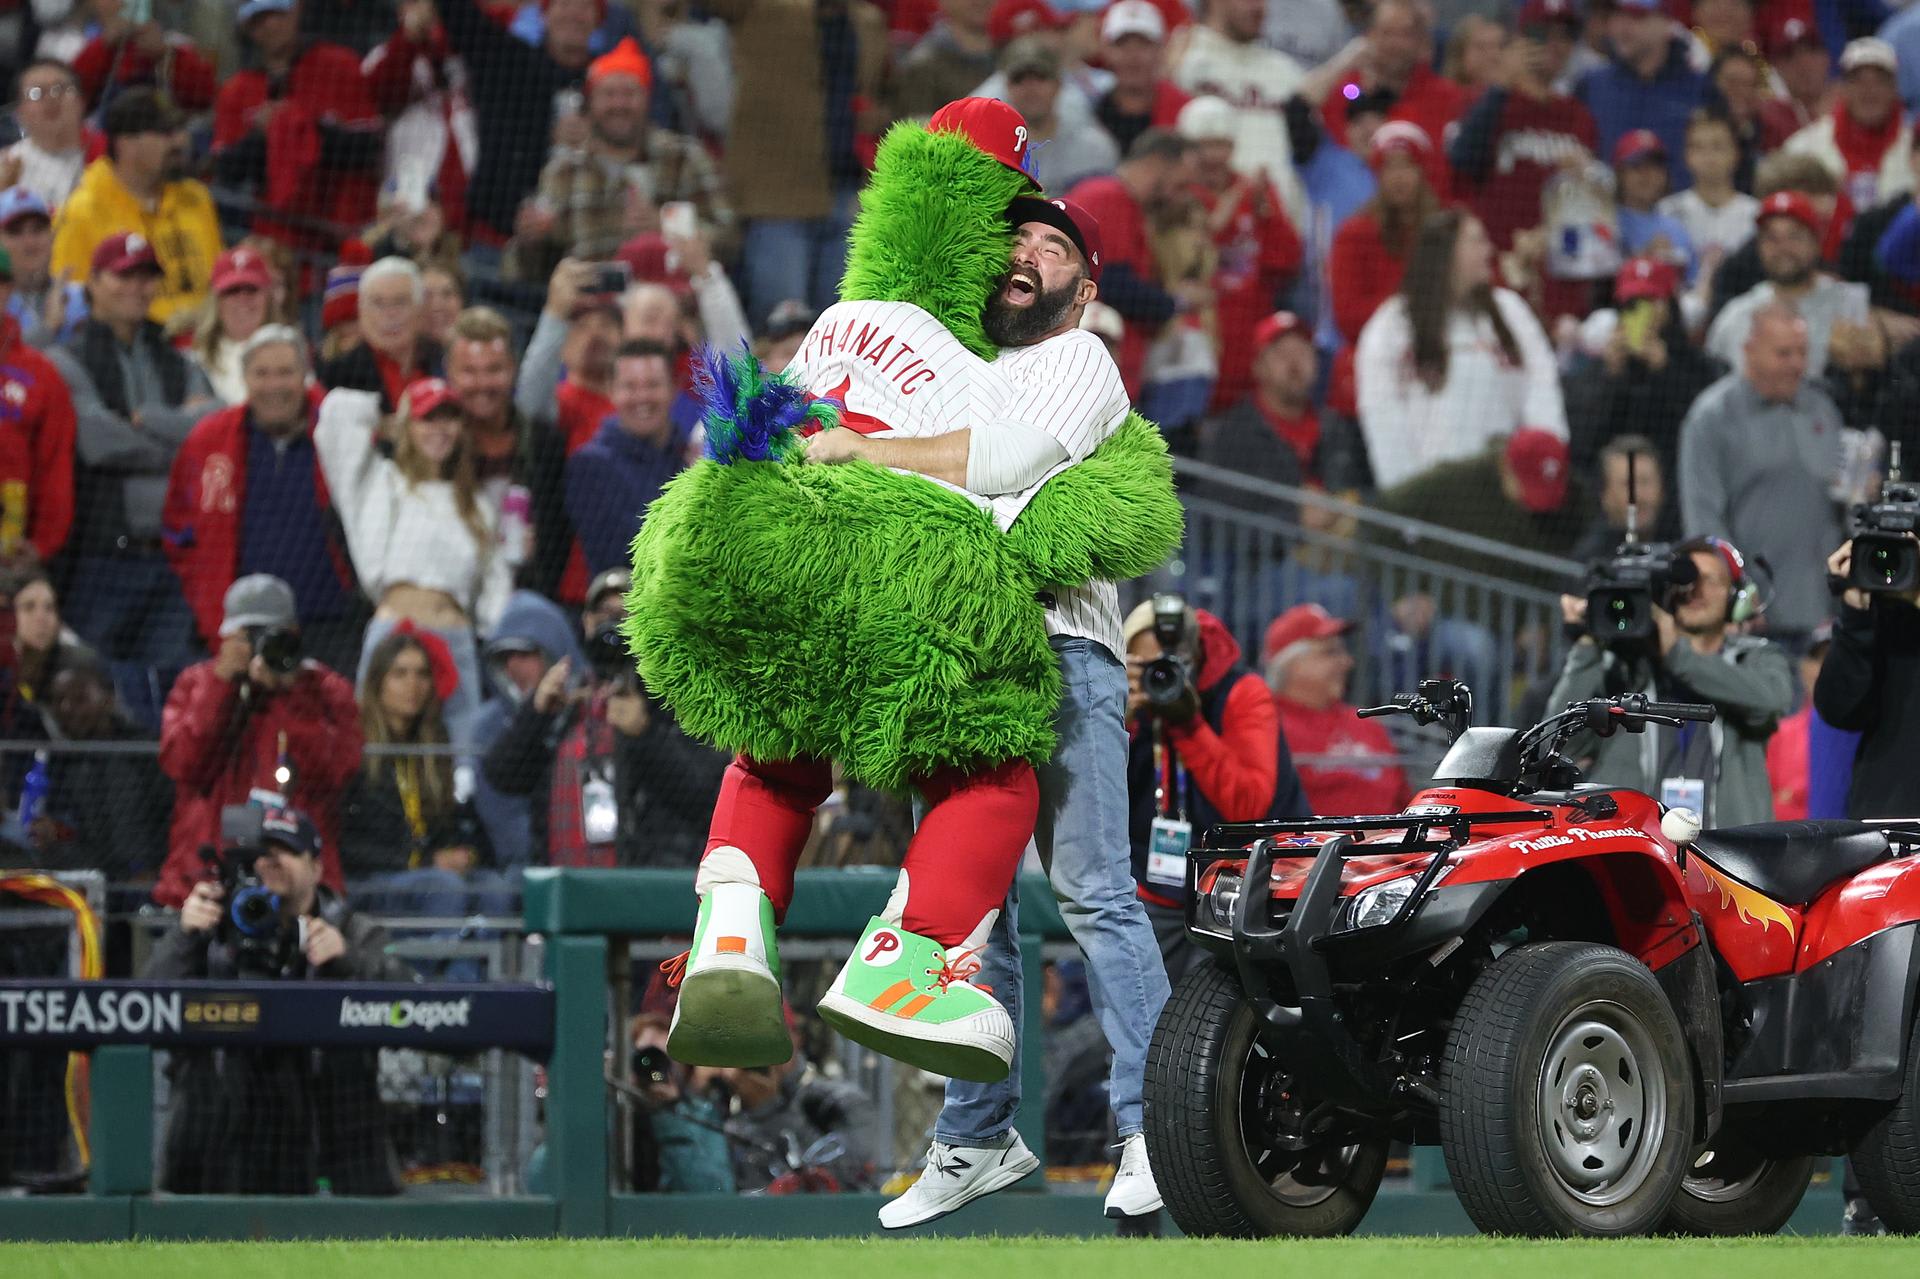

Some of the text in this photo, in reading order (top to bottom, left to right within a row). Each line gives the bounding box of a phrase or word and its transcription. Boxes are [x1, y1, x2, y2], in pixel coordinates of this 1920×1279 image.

[1014, 125, 1028, 153] P
[804, 318, 936, 395] PHANATIC
[1508, 827, 1651, 854] Phillie Phanatic
[864, 931, 899, 962] P
[0, 991, 261, 1034] TSEASON 2022
[339, 996, 471, 1032] loanDepot
